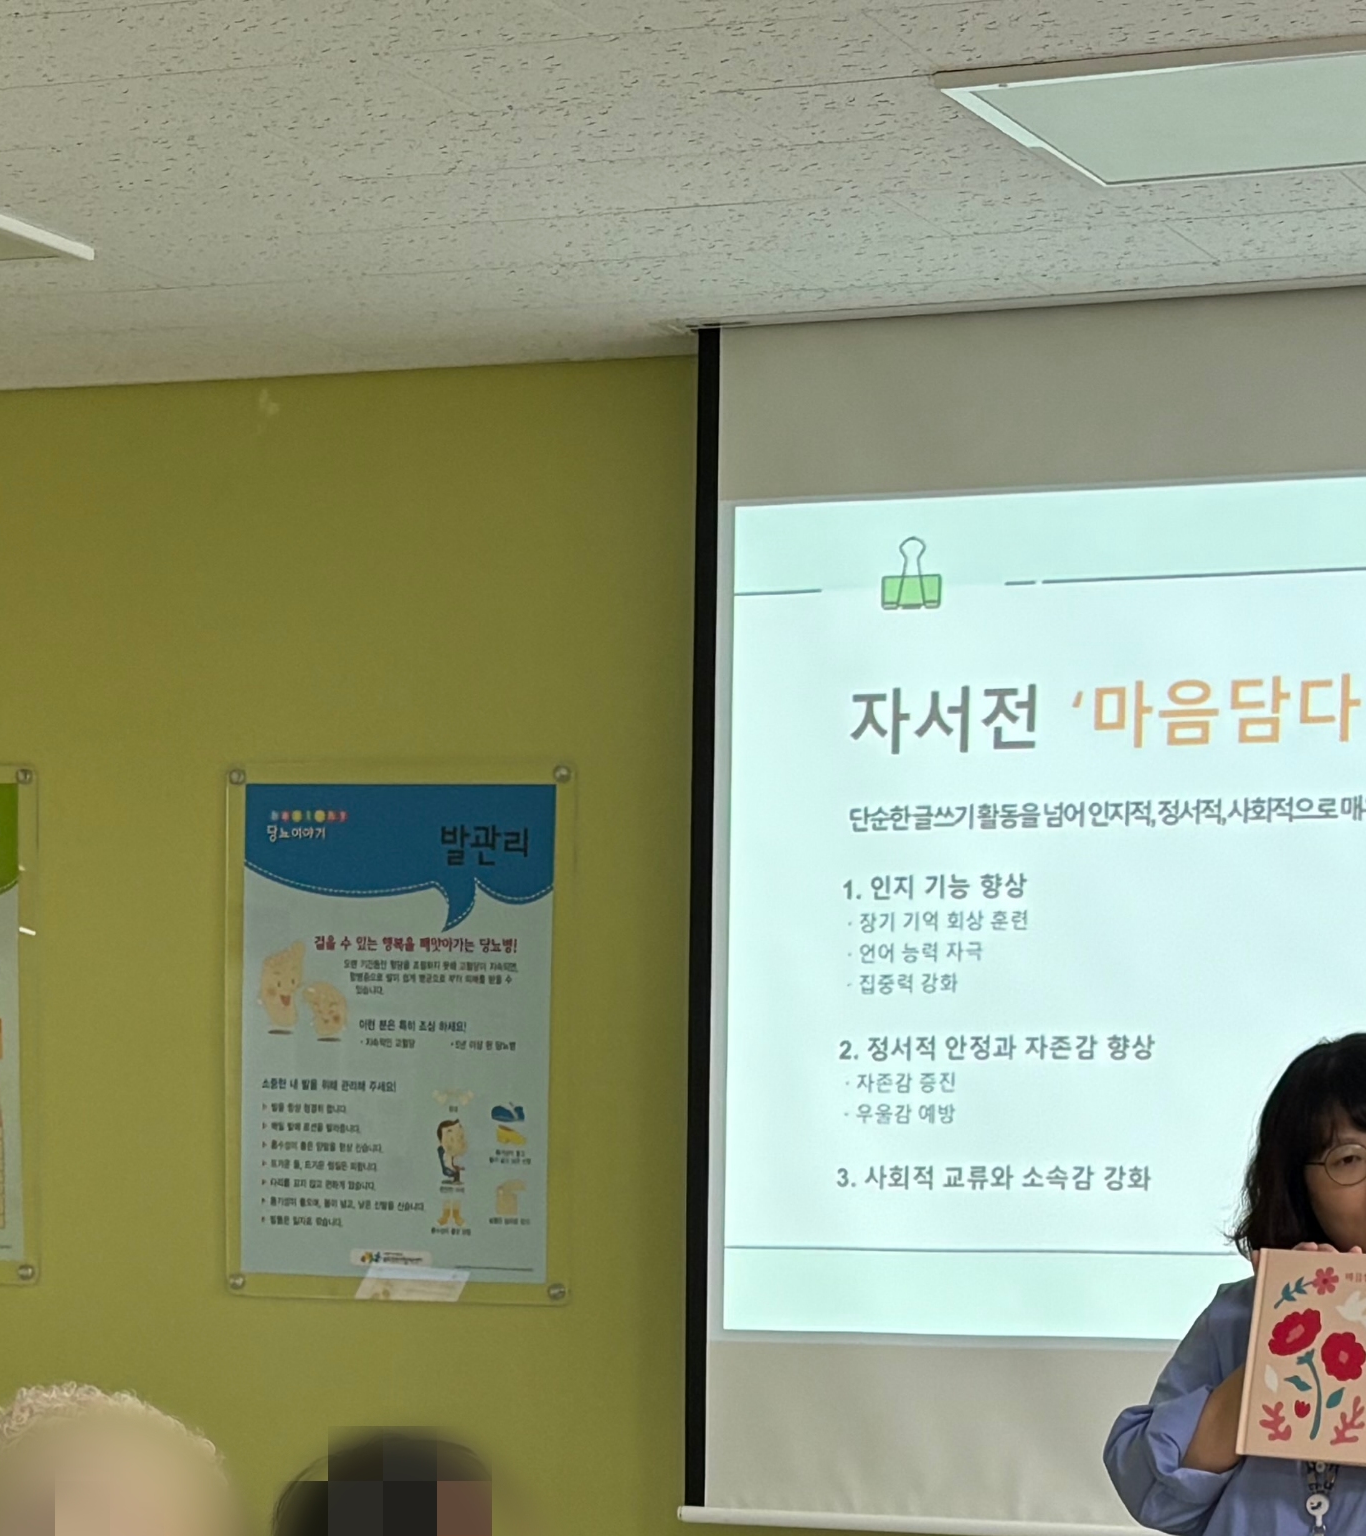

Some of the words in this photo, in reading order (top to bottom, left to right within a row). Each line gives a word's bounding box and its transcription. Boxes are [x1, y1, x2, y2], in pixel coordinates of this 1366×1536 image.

[850, 683, 1037, 755] 자서전
[848, 805, 912, 833] 단순한
[912, 804, 975, 831] 글쓰기
[976, 802, 1040, 830] 활동을
[1043, 801, 1085, 828] 넘어
[1088, 800, 1156, 829] 인지적,
[1157, 797, 1227, 826] 정서적,
[1227, 796, 1339, 824] 사회적으로
[440, 824, 529, 867] 발관리
[842, 879, 863, 900] 1.
[870, 874, 914, 901] 인지
[924, 873, 971, 900] 기능
[979, 872, 1028, 899] 향상
[859, 911, 895, 933] 장기
[902, 910, 939, 932] 기억
[946, 909, 983, 931] 회상
[989, 909, 1028, 931] 훈련
[339, 935, 353, 952] 수
[355, 935, 379, 952] 있는
[859, 943, 895, 964] 언어
[901, 942, 938, 963] 능력
[946, 941, 983, 962] 자극
[858, 973, 914, 995] 집중력
[921, 972, 958, 994] 강화
[838, 1040, 859, 1061] 2.
[867, 1034, 936, 1062] 정서적
[944, 1034, 1017, 1061] 안정과
[1024, 1034, 1099, 1061] 자존감
[1106, 1033, 1156, 1061] 향상
[856, 1072, 913, 1094] 자존감
[918, 1071, 956, 1093] 증진
[855, 1103, 913, 1125] 우울감
[918, 1103, 956, 1125] 예방
[836, 1168, 857, 1188] 3.
[864, 1165, 935, 1191] 사회적
[942, 1165, 1014, 1190] 교류와
[1021, 1165, 1095, 1191] 소속감
[1103, 1165, 1152, 1192] 강화
